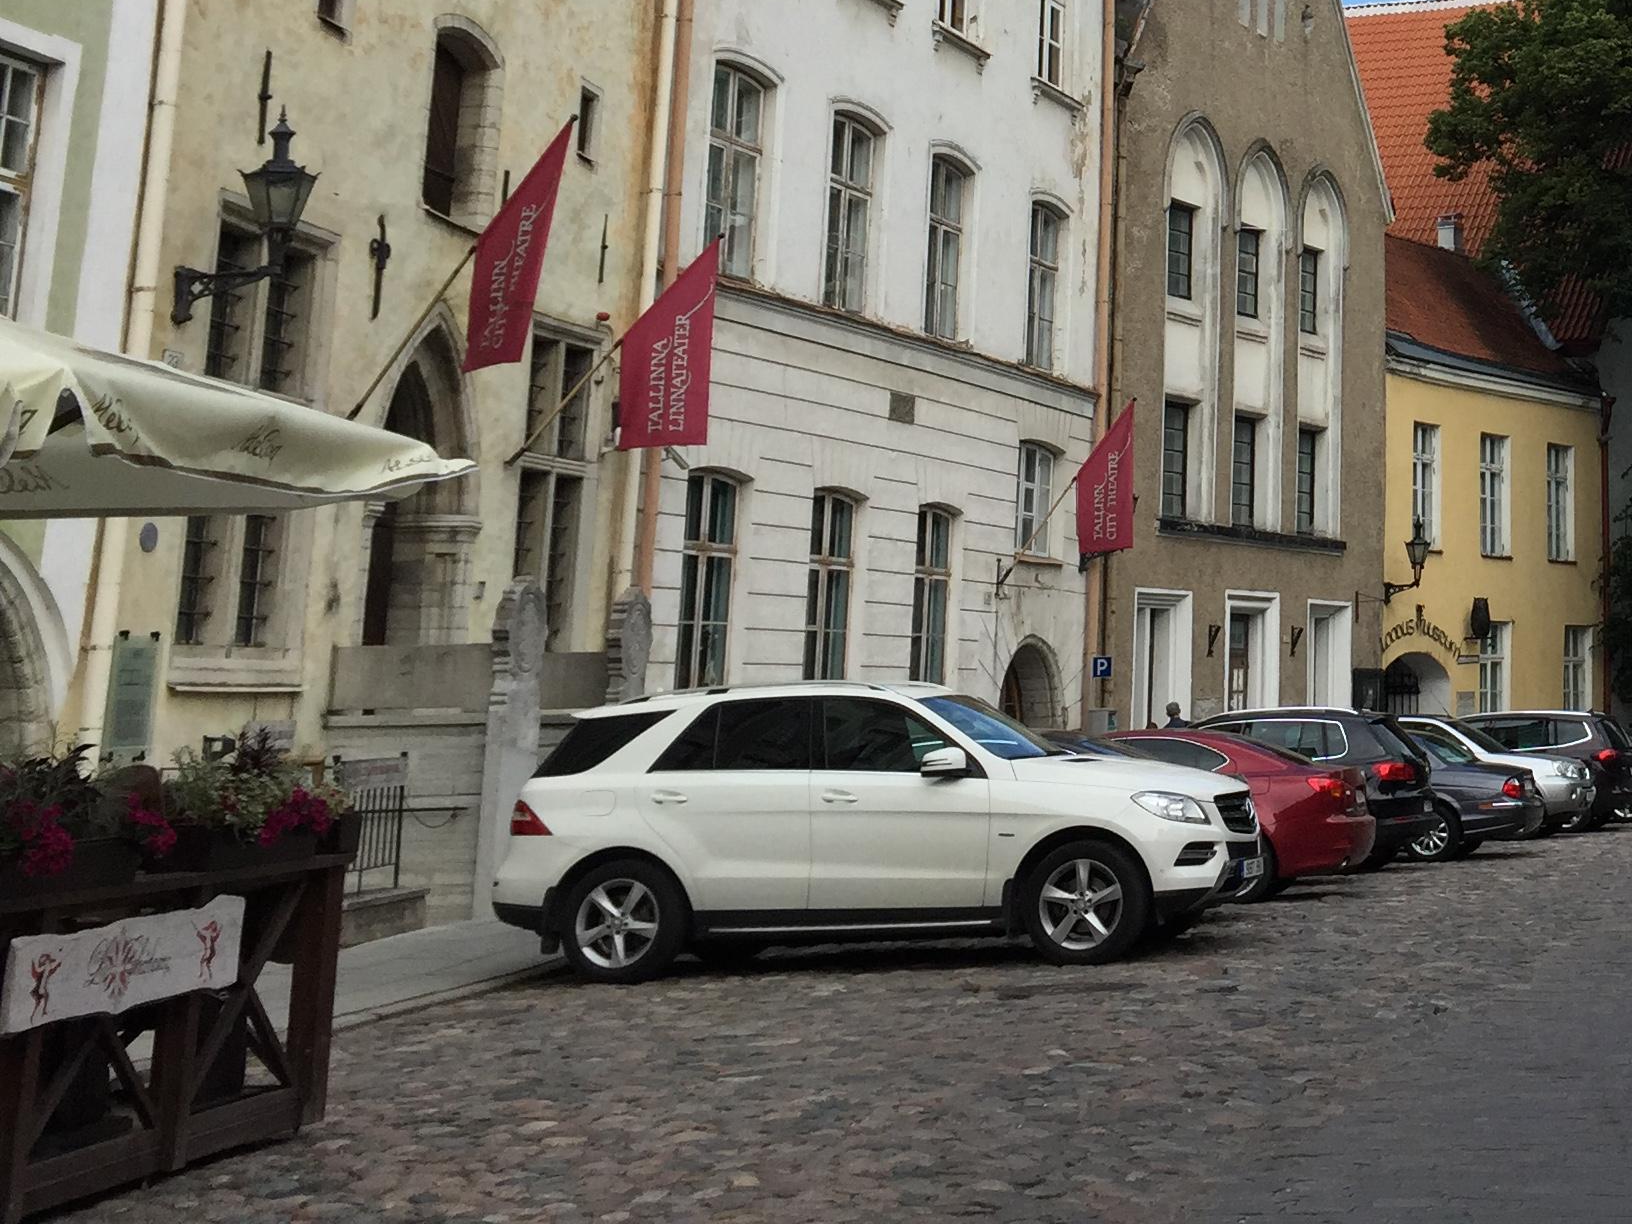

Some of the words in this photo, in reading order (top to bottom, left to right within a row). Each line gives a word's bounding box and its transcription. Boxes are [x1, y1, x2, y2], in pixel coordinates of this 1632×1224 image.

[648, 336, 670, 433] TALLINNA
[669, 313, 691, 432] LINNATEATER
[1107, 451, 1119, 507] THEATRE
[1093, 478, 1106, 541] TALLINN
[1105, 512, 1117, 540] CITY
[1096, 658, 1108, 676] P
